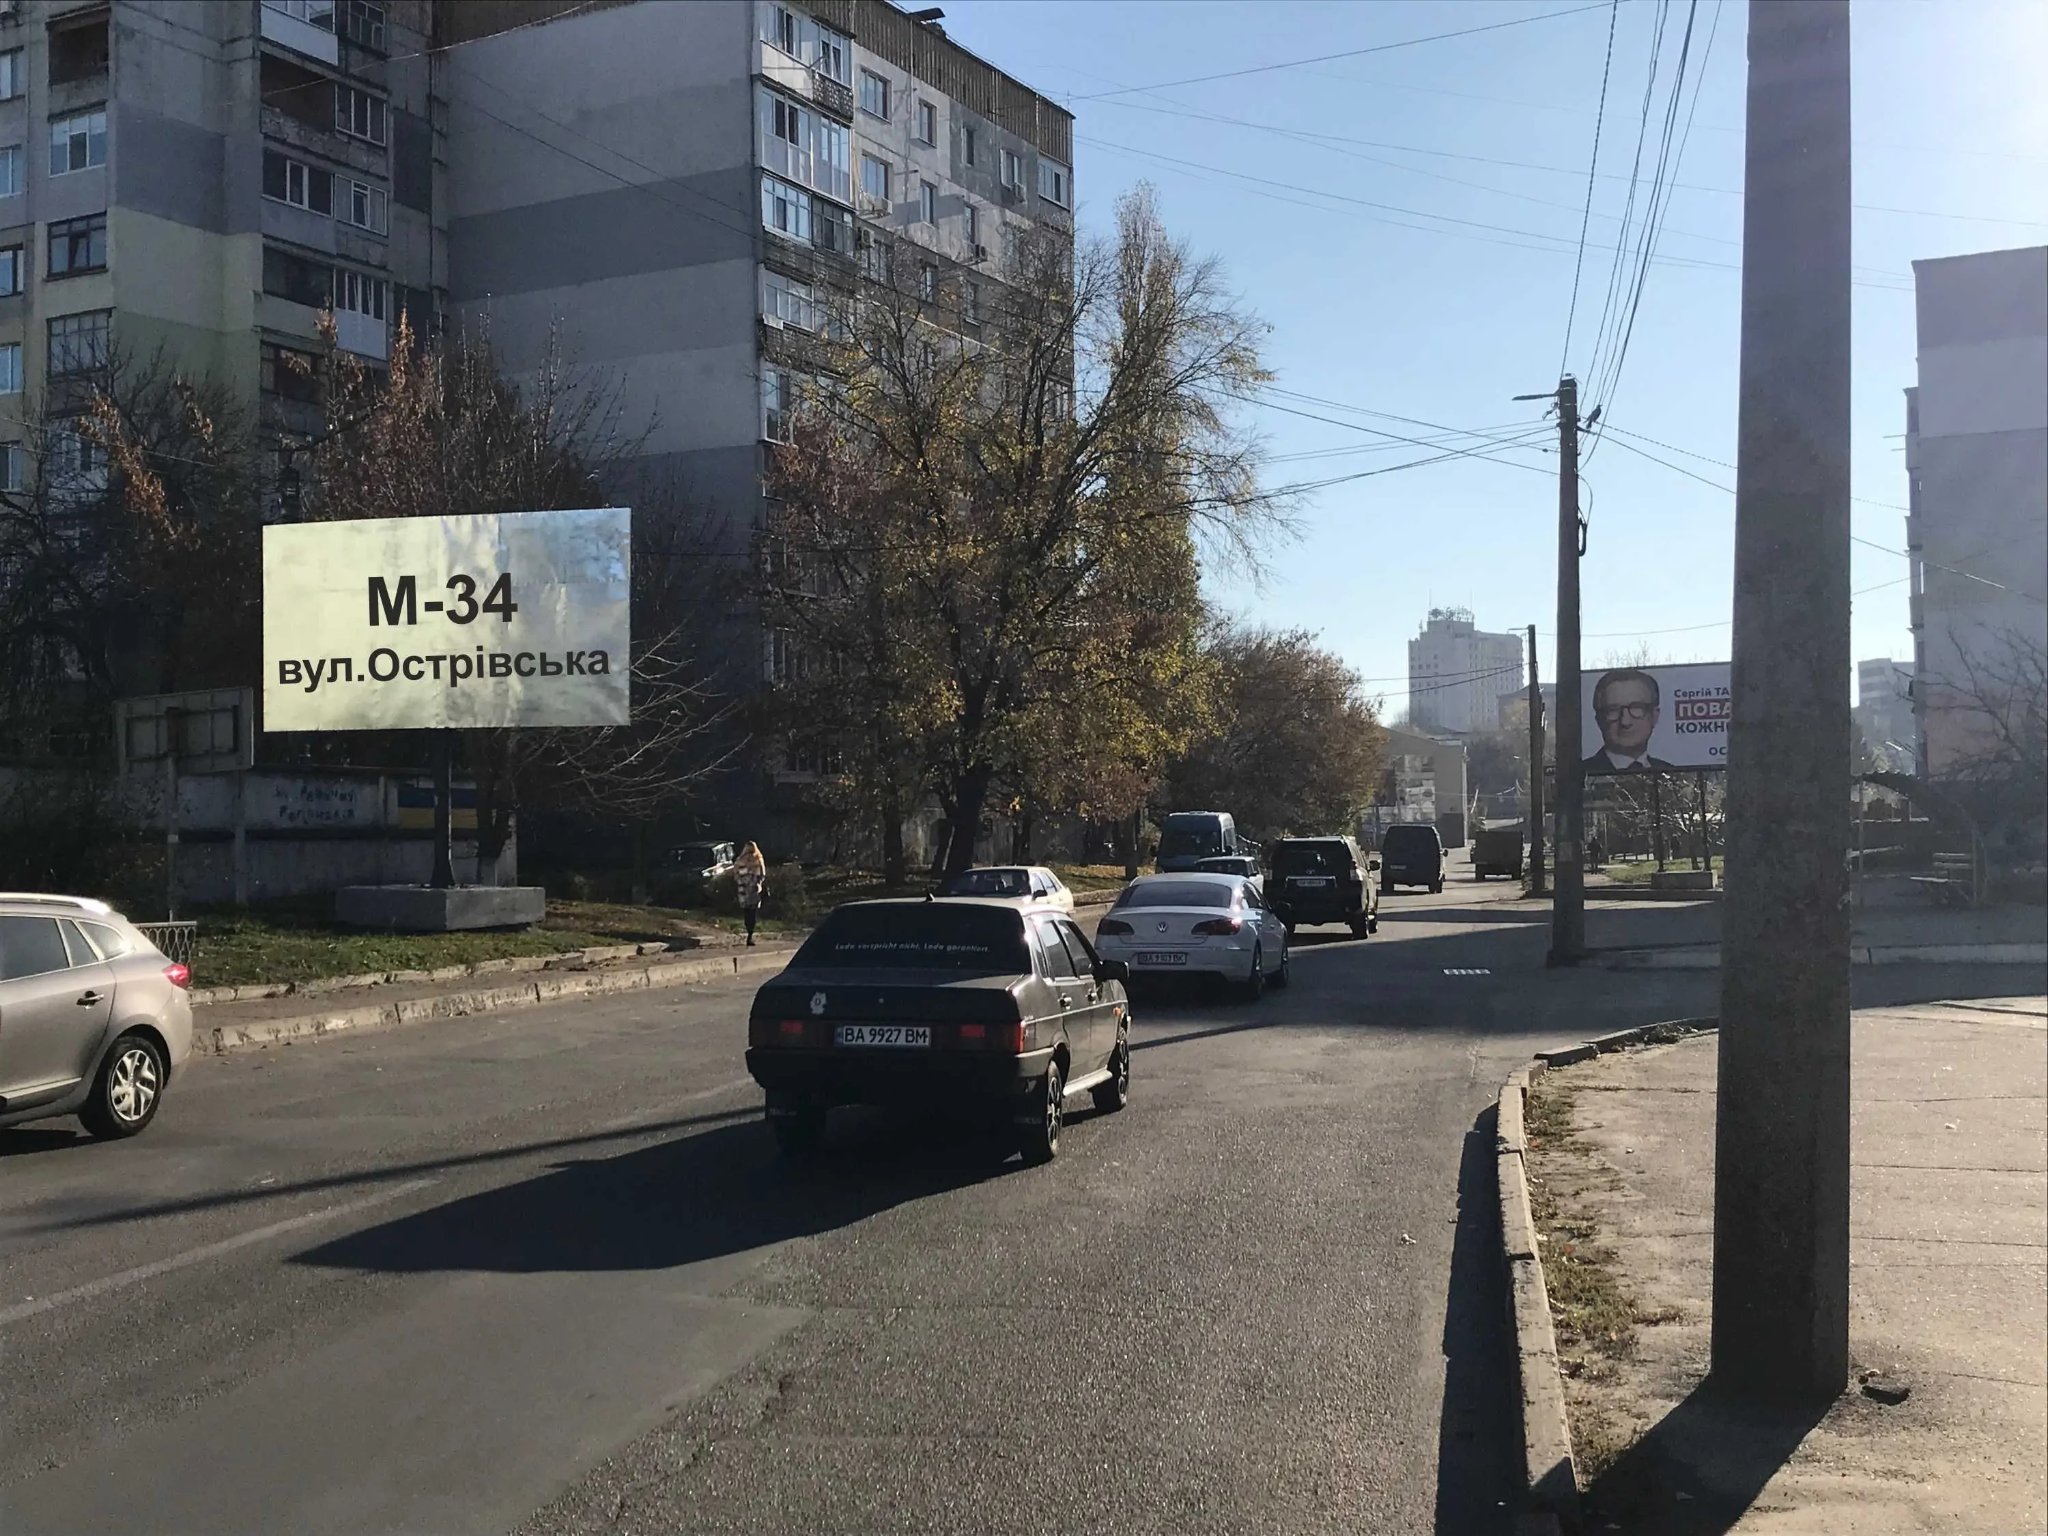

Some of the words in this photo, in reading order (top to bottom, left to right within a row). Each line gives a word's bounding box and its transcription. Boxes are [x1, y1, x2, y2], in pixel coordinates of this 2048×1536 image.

[368, 573, 518, 627] М-34
[278, 645, 611, 694] вул.Острівська
[1674, 687, 1712, 699] Сергій
[1675, 722, 1729, 734] КОЖН
[924, 942, 944, 950] Lada
[844, 1028, 865, 1042] BA
[869, 1028, 902, 1043] 9927
[905, 1029, 928, 1044] BM
